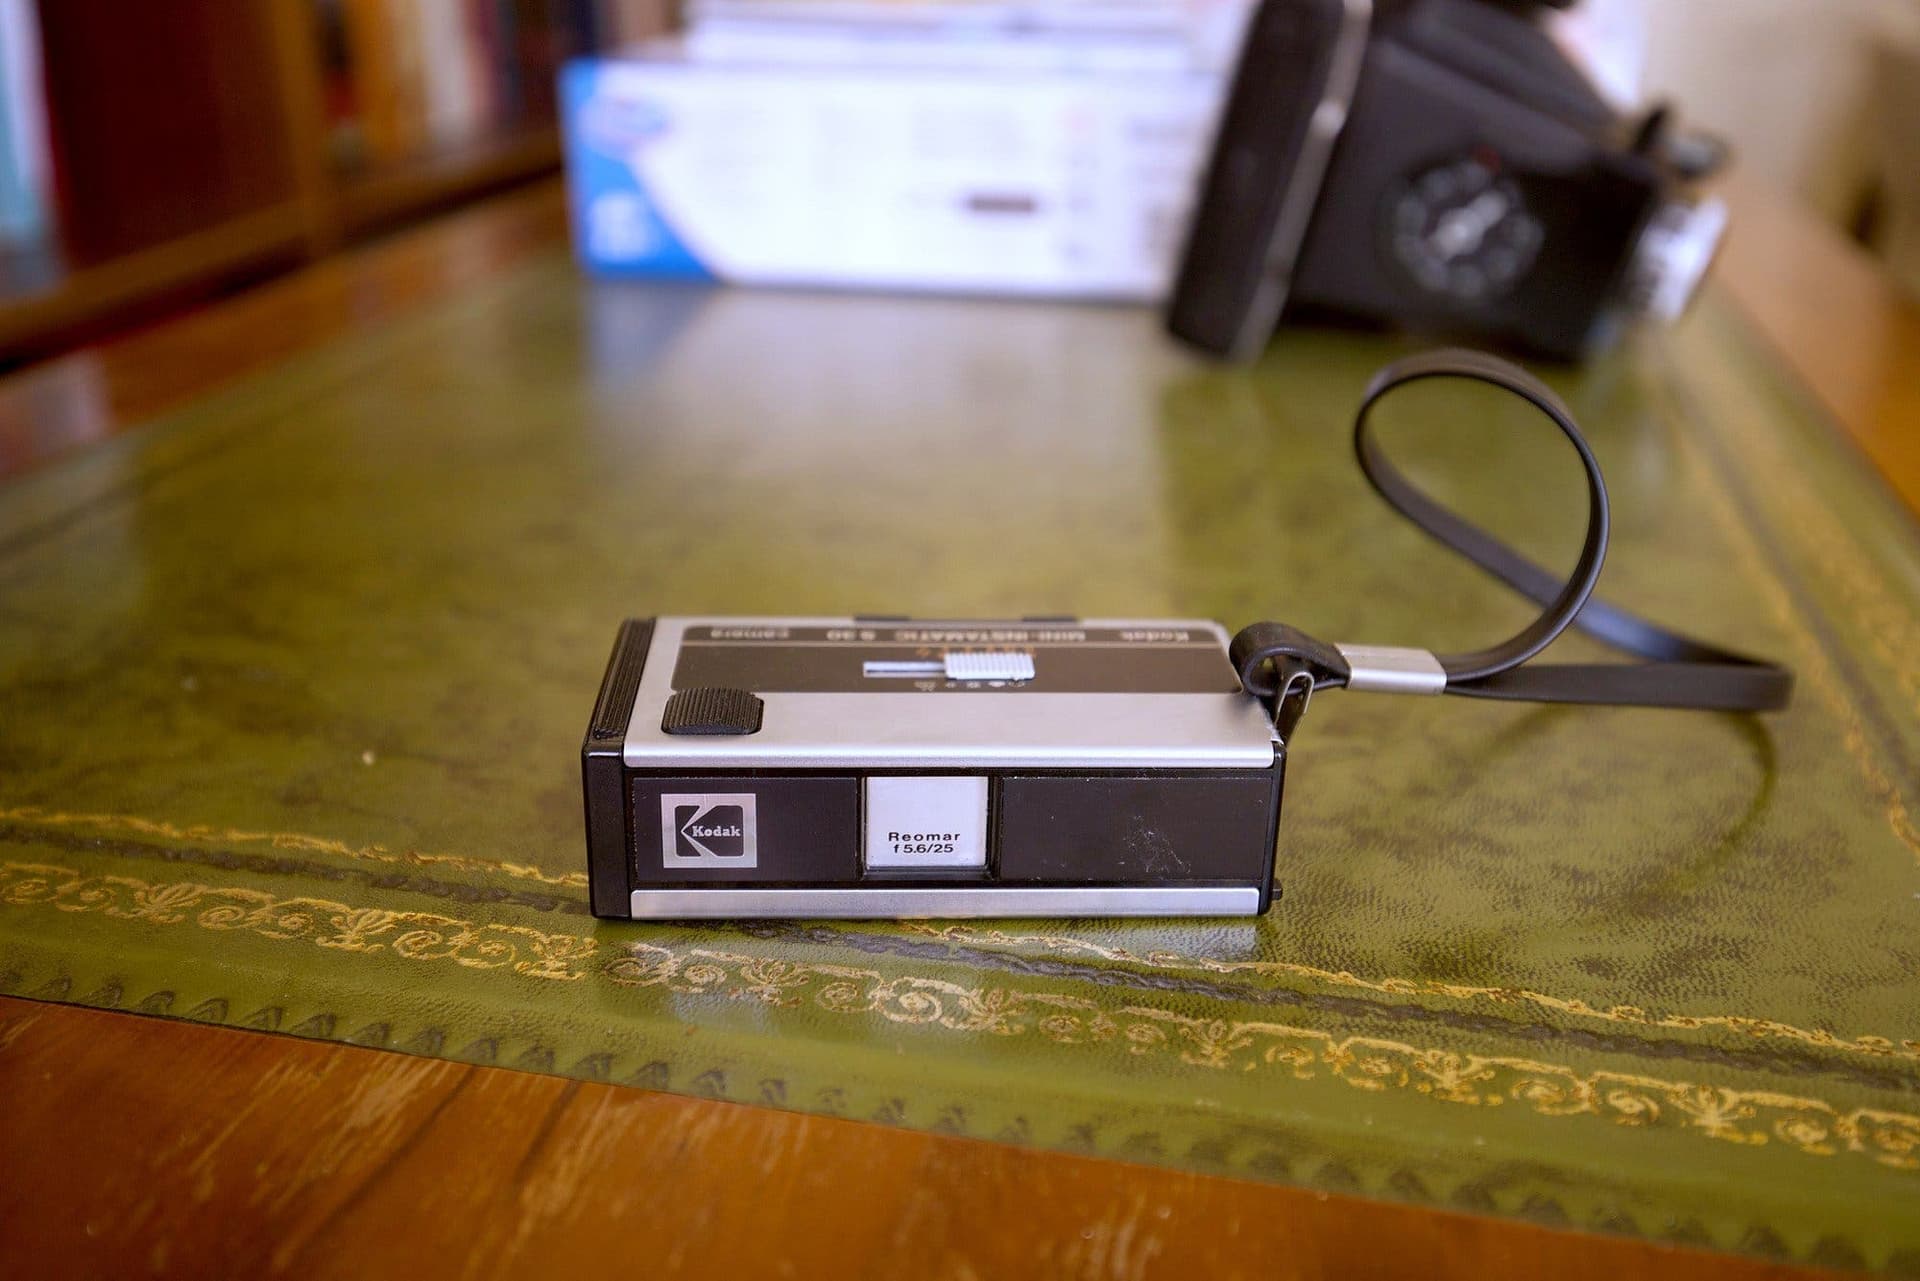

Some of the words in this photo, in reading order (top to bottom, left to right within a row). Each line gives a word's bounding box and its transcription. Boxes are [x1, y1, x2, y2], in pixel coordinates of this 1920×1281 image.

[691, 825, 741, 837] Kodak
[888, 831, 961, 842] Reomar
[903, 843, 954, 854] 5.6/25
